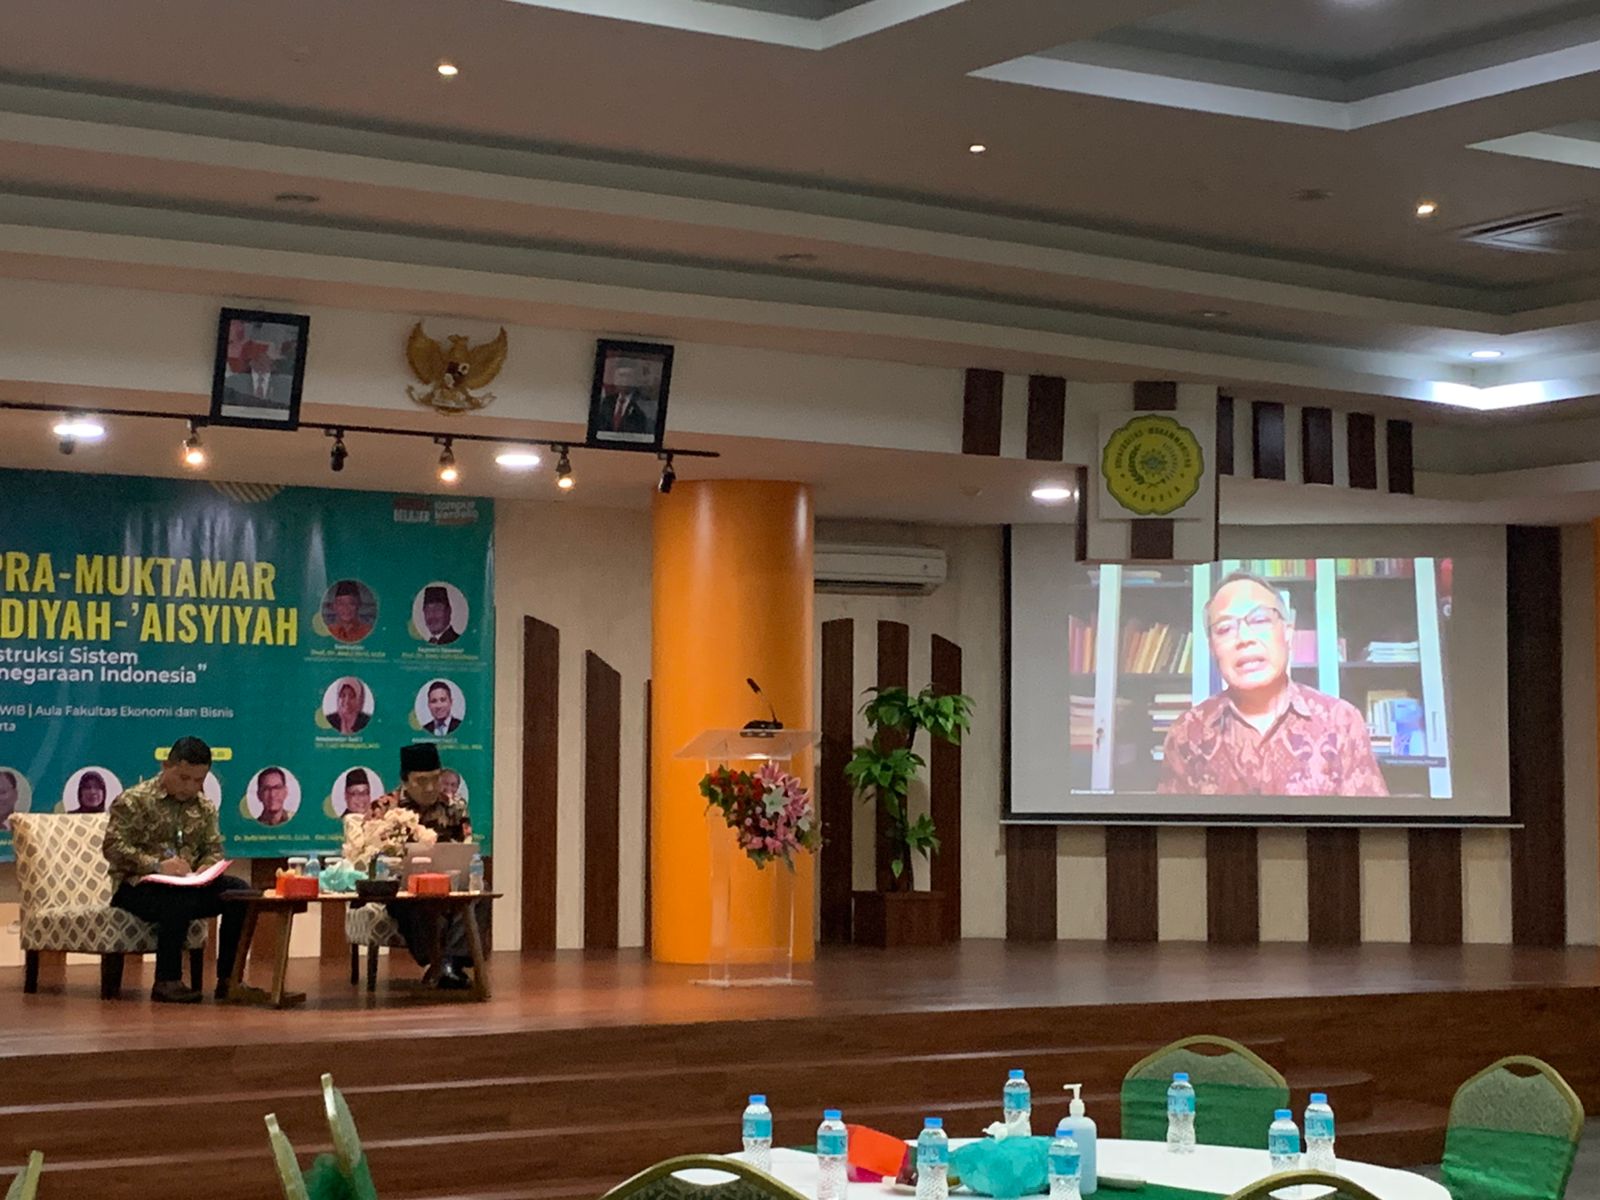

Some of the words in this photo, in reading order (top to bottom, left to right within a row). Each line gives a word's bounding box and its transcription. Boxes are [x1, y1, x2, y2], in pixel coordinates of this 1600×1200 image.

[0, 551, 276, 601] RA-MUKTAMAR
[69, 646, 139, 665] Sistem
[0, 665, 94, 685] negaraan
[0, 705, 27, 717] WIB
[35, 705, 63, 717] Aula
[65, 705, 118, 718] Fakultas
[120, 706, 173, 718] Ekonomi
[175, 707, 198, 718] dan
[200, 707, 234, 719] Bisnis
